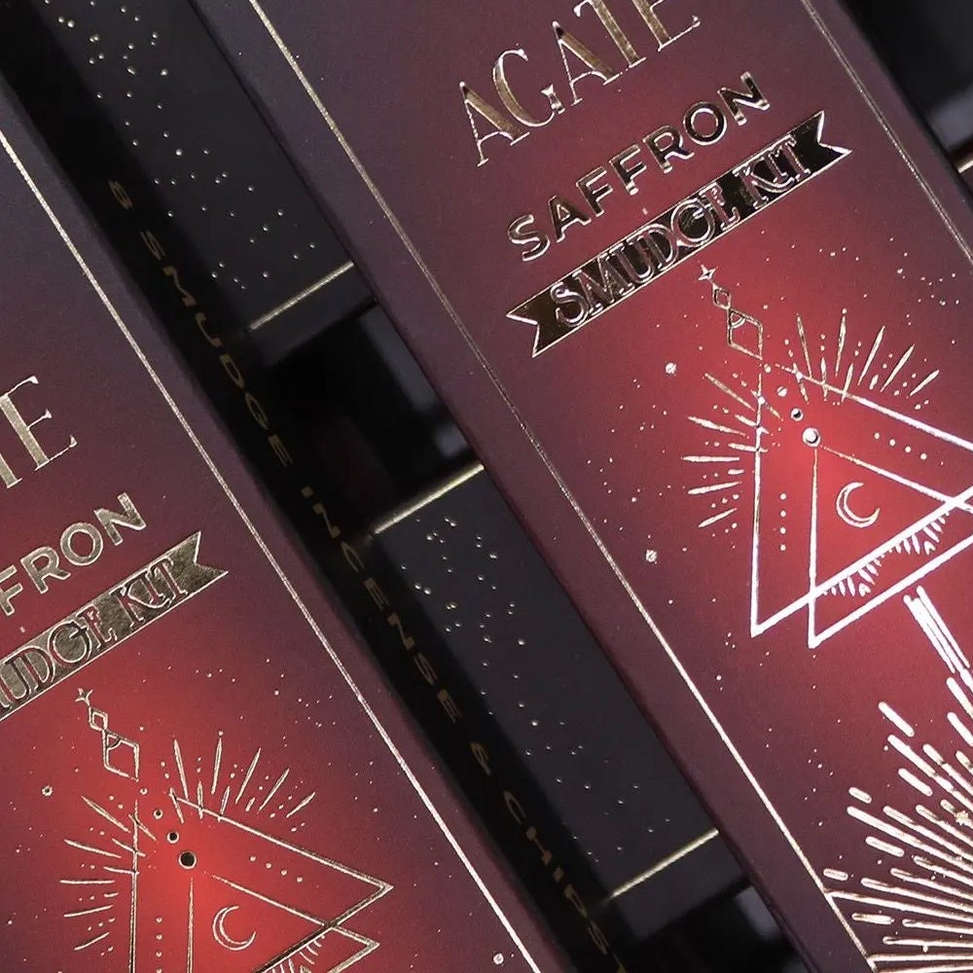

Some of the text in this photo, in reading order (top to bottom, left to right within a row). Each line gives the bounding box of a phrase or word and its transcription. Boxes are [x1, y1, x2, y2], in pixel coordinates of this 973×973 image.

[508, 71, 770, 262] SAFFRON
[550, 134, 812, 327] SMUDGE KIT
[139, 230, 295, 468] SMUDGE
[300, 485, 464, 725] INCENSE
[0, 557, 190, 709] UDGE KIT
